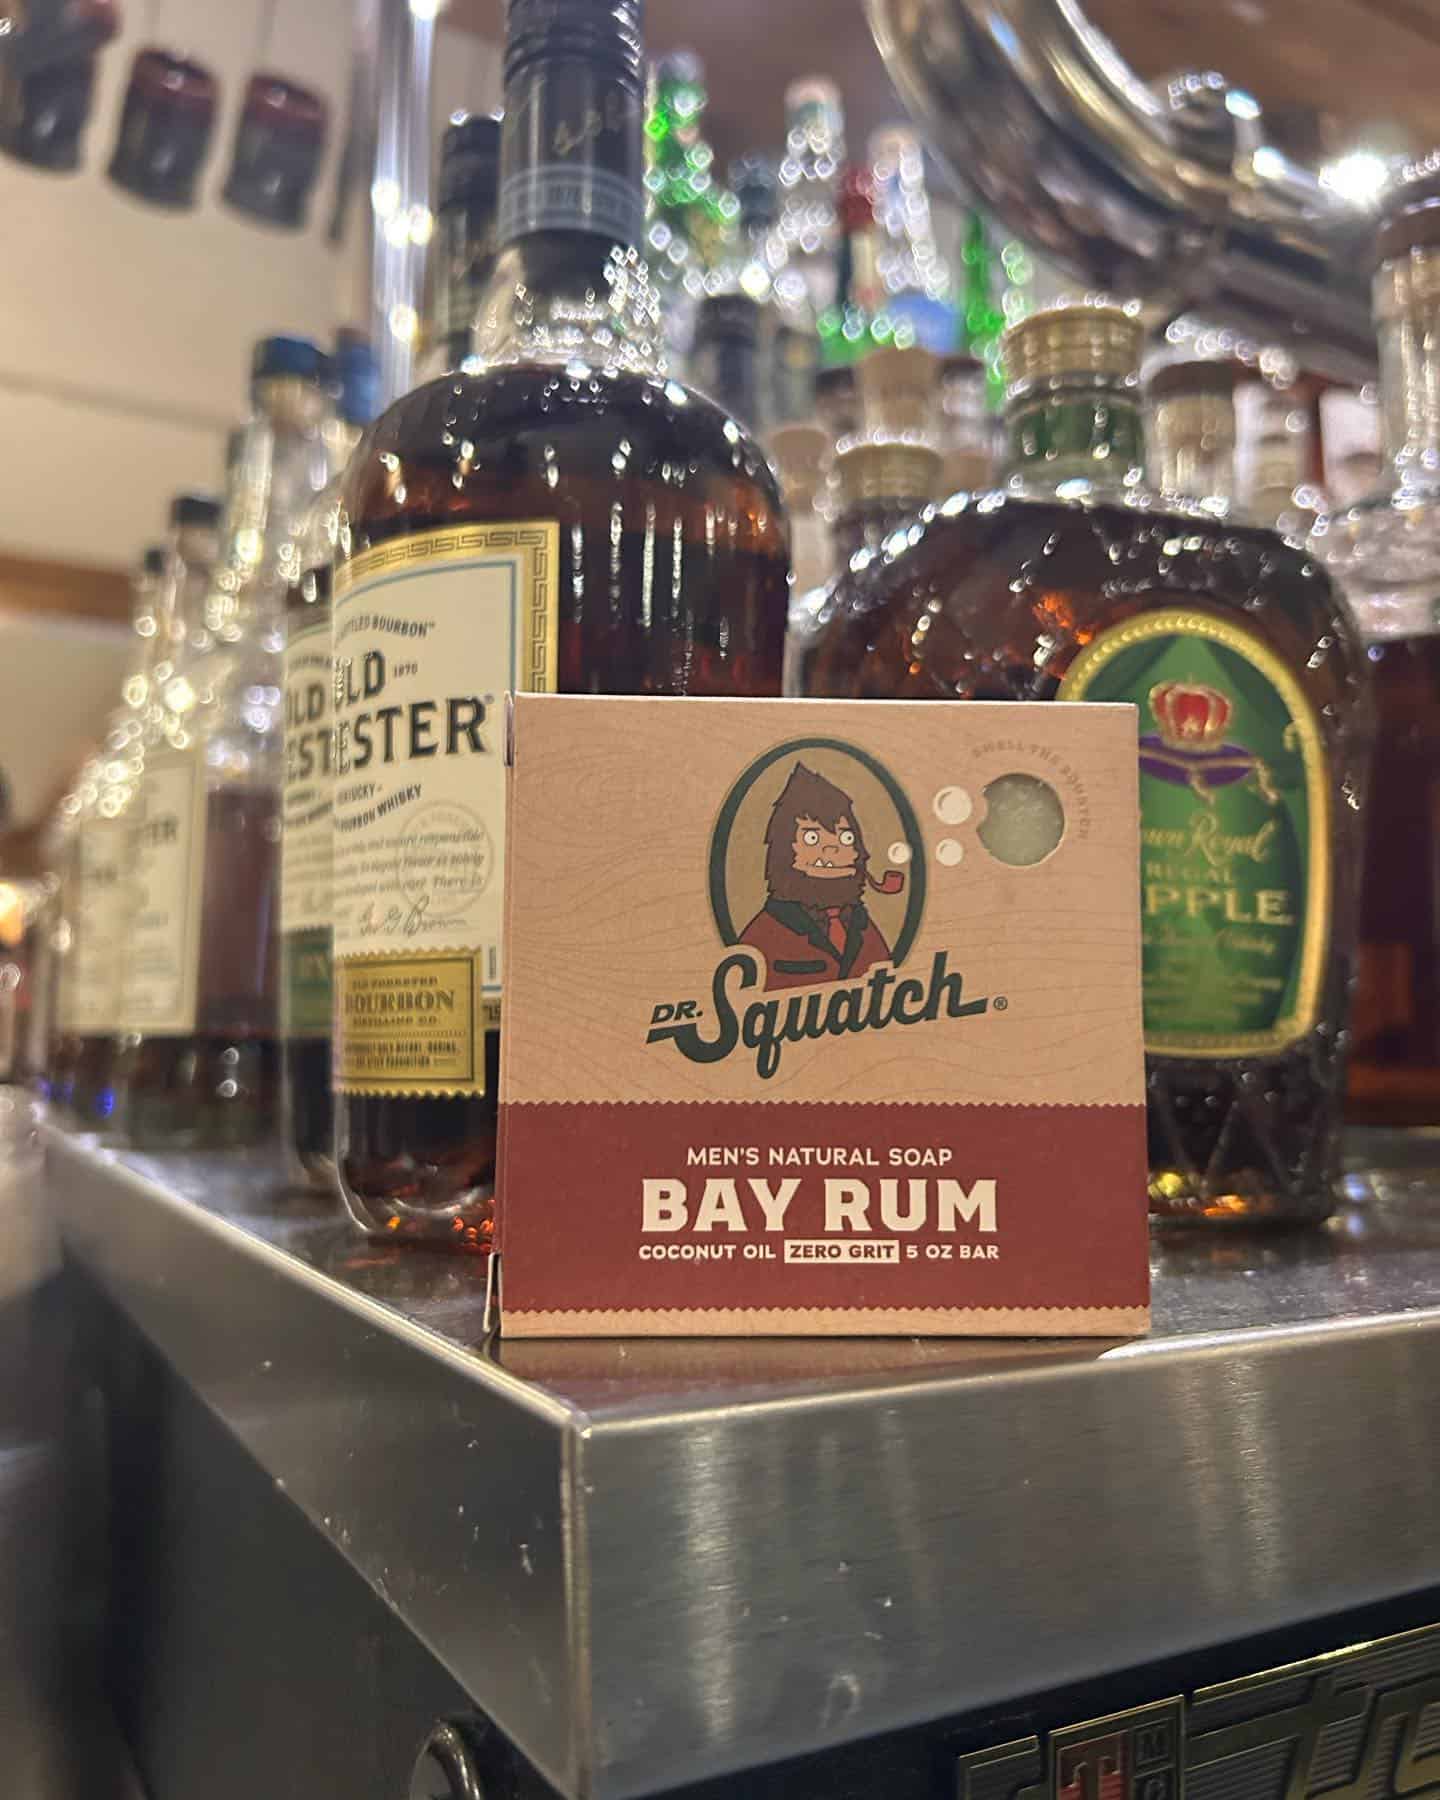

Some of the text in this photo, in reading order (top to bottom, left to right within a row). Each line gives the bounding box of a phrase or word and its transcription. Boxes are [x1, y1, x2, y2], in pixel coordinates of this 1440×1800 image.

[373, 614, 428, 638] BOURBON
[1146, 884, 1296, 926] PPLE
[646, 951, 988, 1079] DR. Squatch
[687, 1147, 952, 1166] MEN'S NATURAL SOAP
[641, 1178, 998, 1232] BAY RUM
[638, 1245, 999, 1260] COCONUT OIL ZERO GRIT 5 OZ BAR
